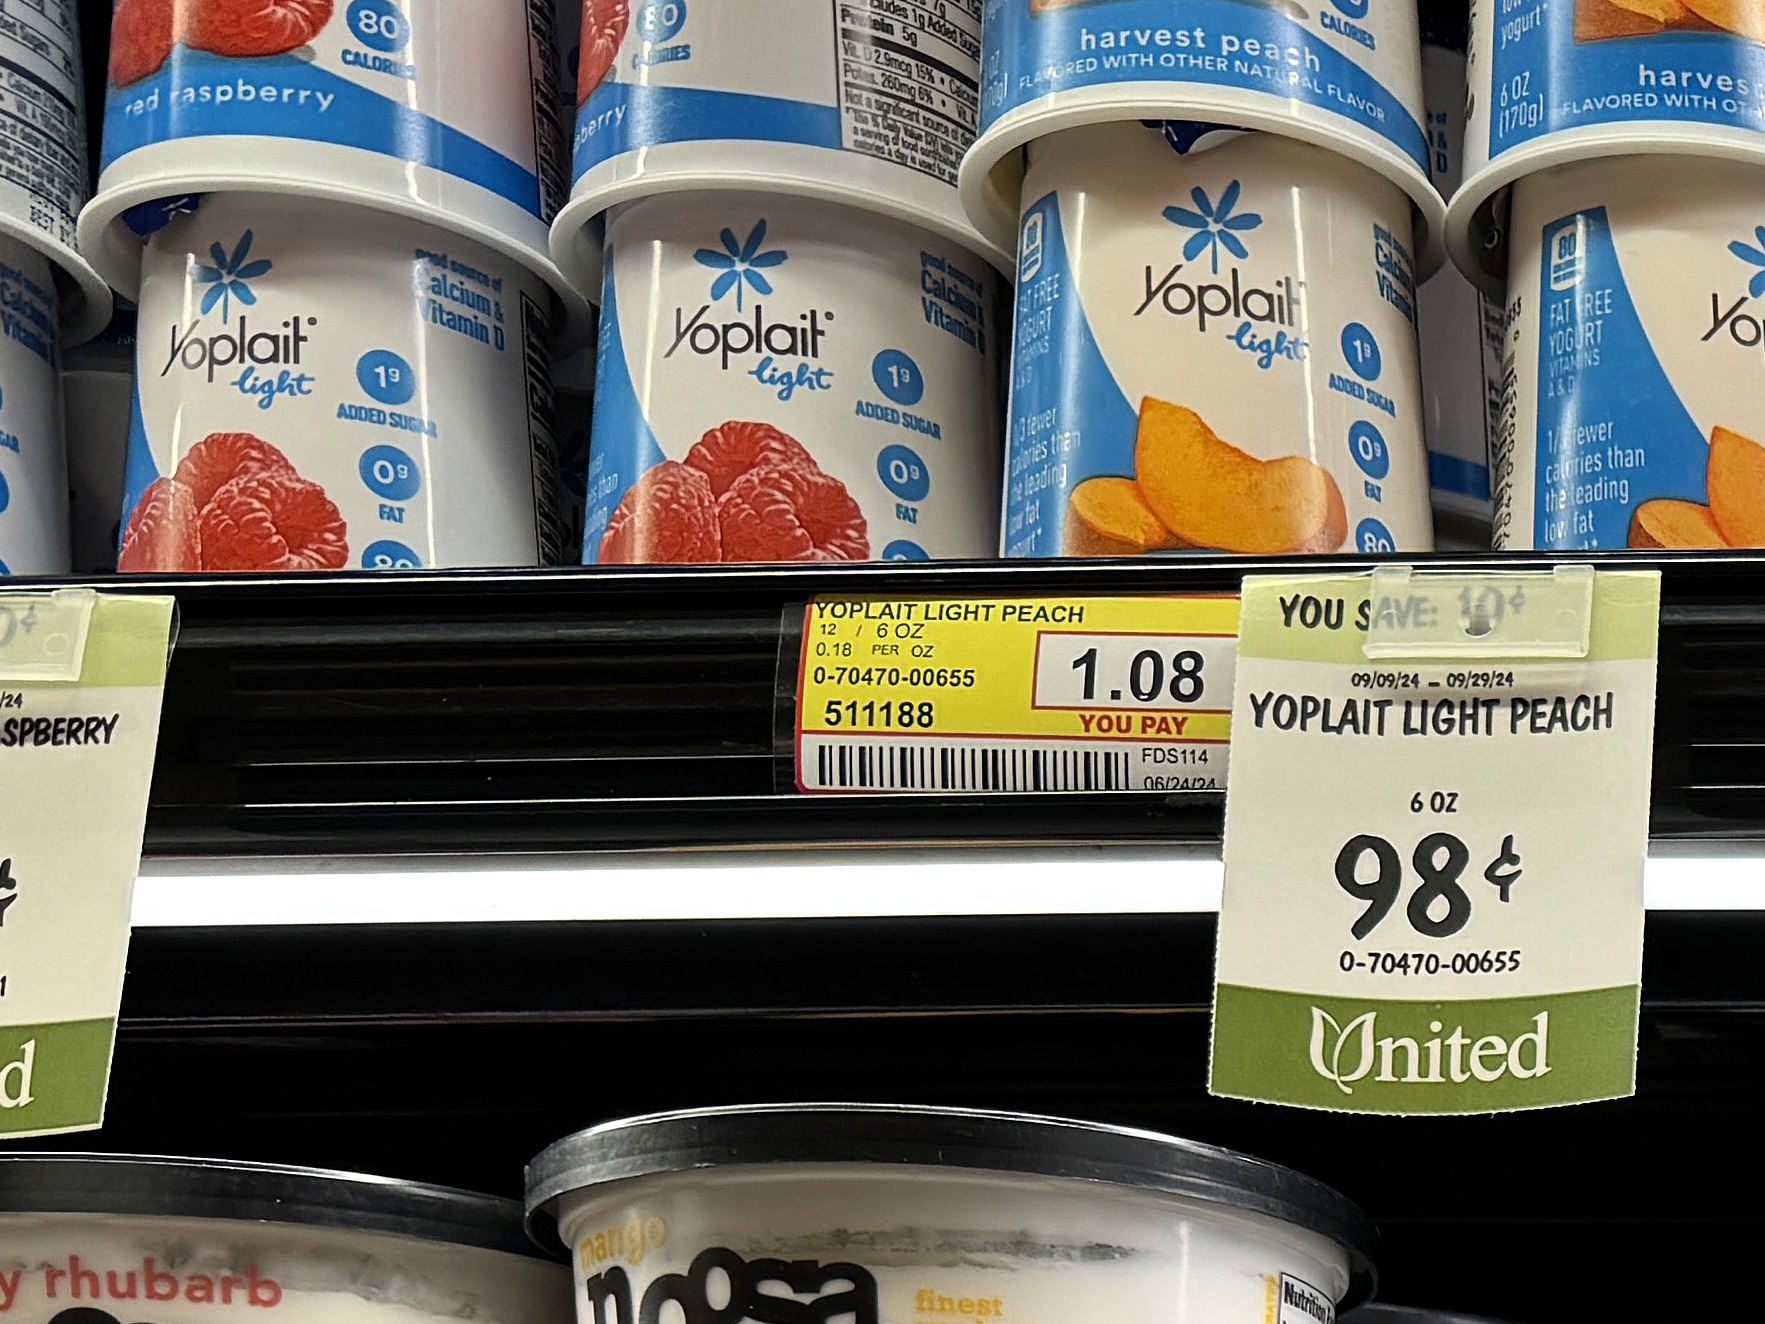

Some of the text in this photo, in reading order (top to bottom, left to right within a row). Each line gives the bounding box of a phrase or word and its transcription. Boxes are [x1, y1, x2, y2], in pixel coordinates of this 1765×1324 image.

[1080, 28, 1321, 72] harvest peach
[1132, 264, 1306, 332] Yoplait
[160, 315, 308, 383] Yoplait
[1226, 322, 1309, 369] light
[230, 365, 316, 410] light
[815, 602, 1084, 624] YOPLAIT LIGHT PEACH
[815, 641, 933, 658] 0.18 PER OZ
[814, 667, 975, 689] 0-70470-00655
[1070, 649, 1205, 702] 1.08
[1351, 670, 1513, 689] 09/09/24 09/29/24
[825, 700, 933, 727] 511188
[1080, 714, 1188, 734] YOU PAY
[1250, 693, 1613, 737] YOPLAIT LIGHT PEACH
[1142, 747, 1209, 765] FDS114
[1411, 793, 1457, 813] 6 OZ
[1340, 951, 1520, 975] 0-70470-00655
[1310, 1006, 1551, 1093] United
